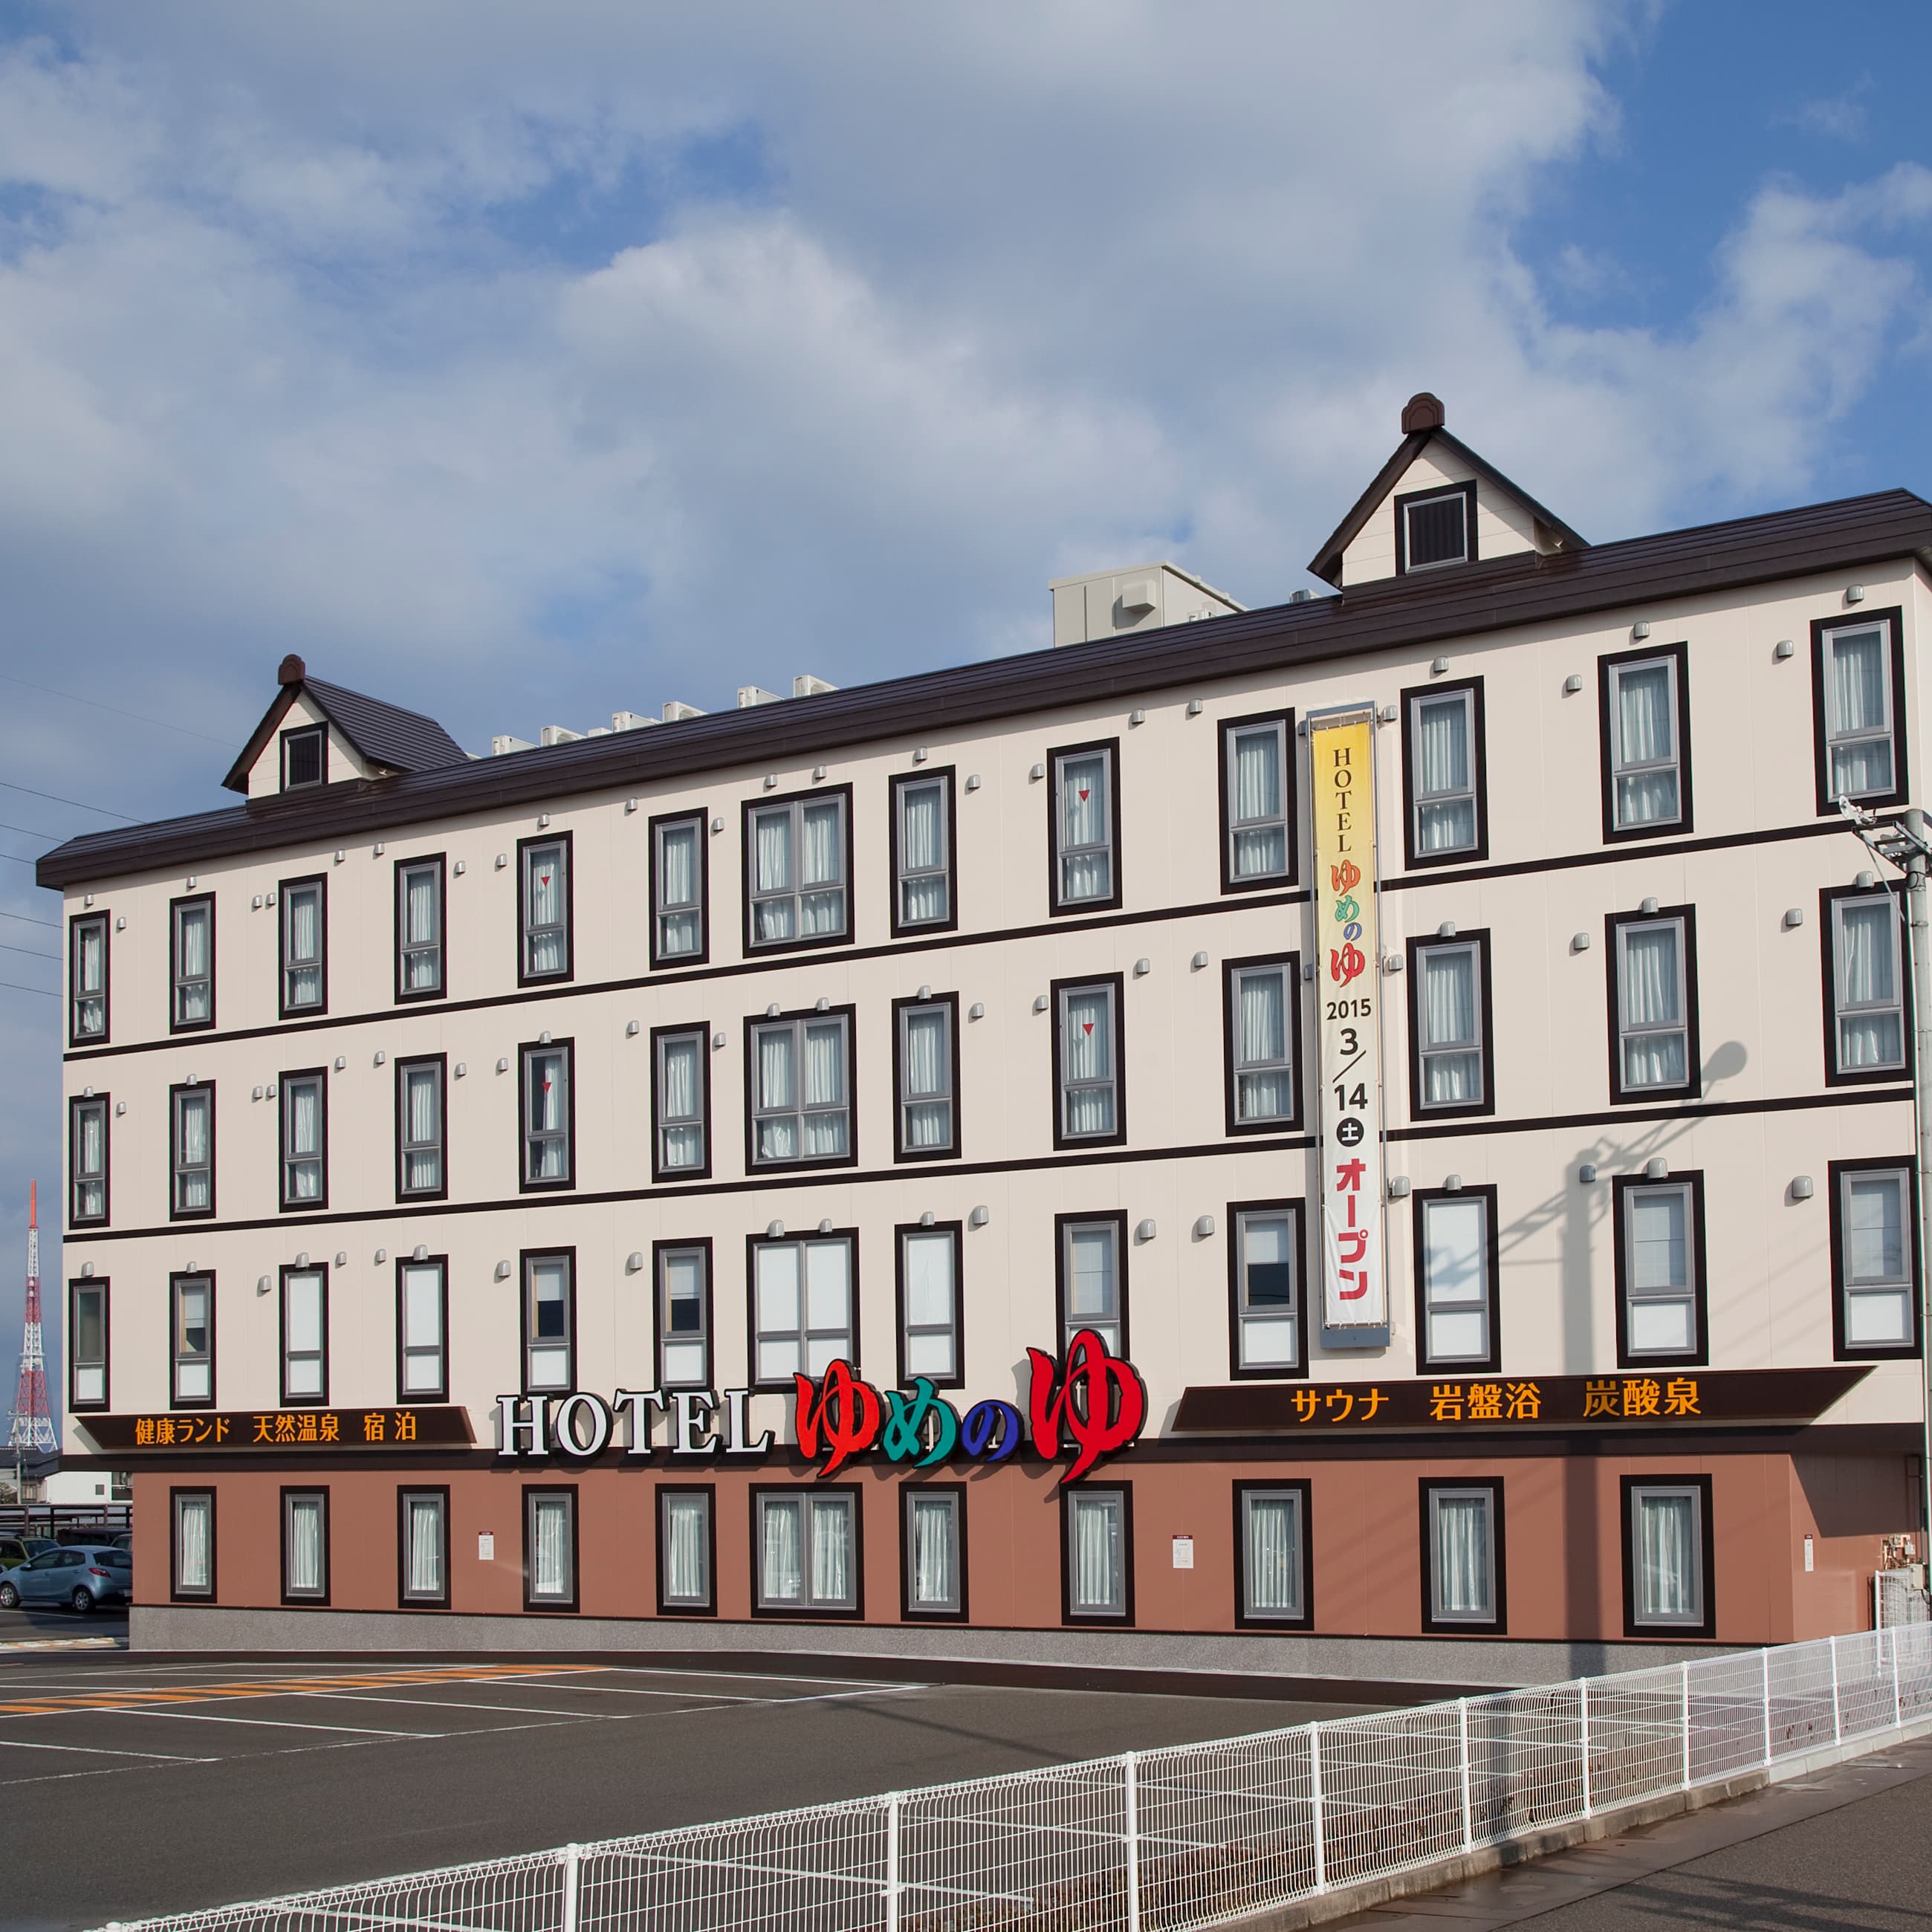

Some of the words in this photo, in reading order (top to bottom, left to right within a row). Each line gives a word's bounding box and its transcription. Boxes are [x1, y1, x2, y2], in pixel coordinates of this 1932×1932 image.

[1333, 748, 1352, 852] HOTEL
[1330, 859, 1366, 988] ゆめのゆ
[1326, 998, 1372, 1020] 2015
[1336, 1158, 1368, 1300] オープン
[134, 1417, 230, 1445] 健康ランド
[253, 1413, 340, 1442] 天然温泉
[363, 1411, 416, 1442] 宿泊
[496, 1389, 775, 1457] HOTEL
[792, 1329, 1147, 1485] ゆめのゆ
[1290, 1388, 1390, 1422] サウナ
[1429, 1381, 1542, 1421] 岩盤浴
[1583, 1377, 1701, 1416] 炭酸泉
